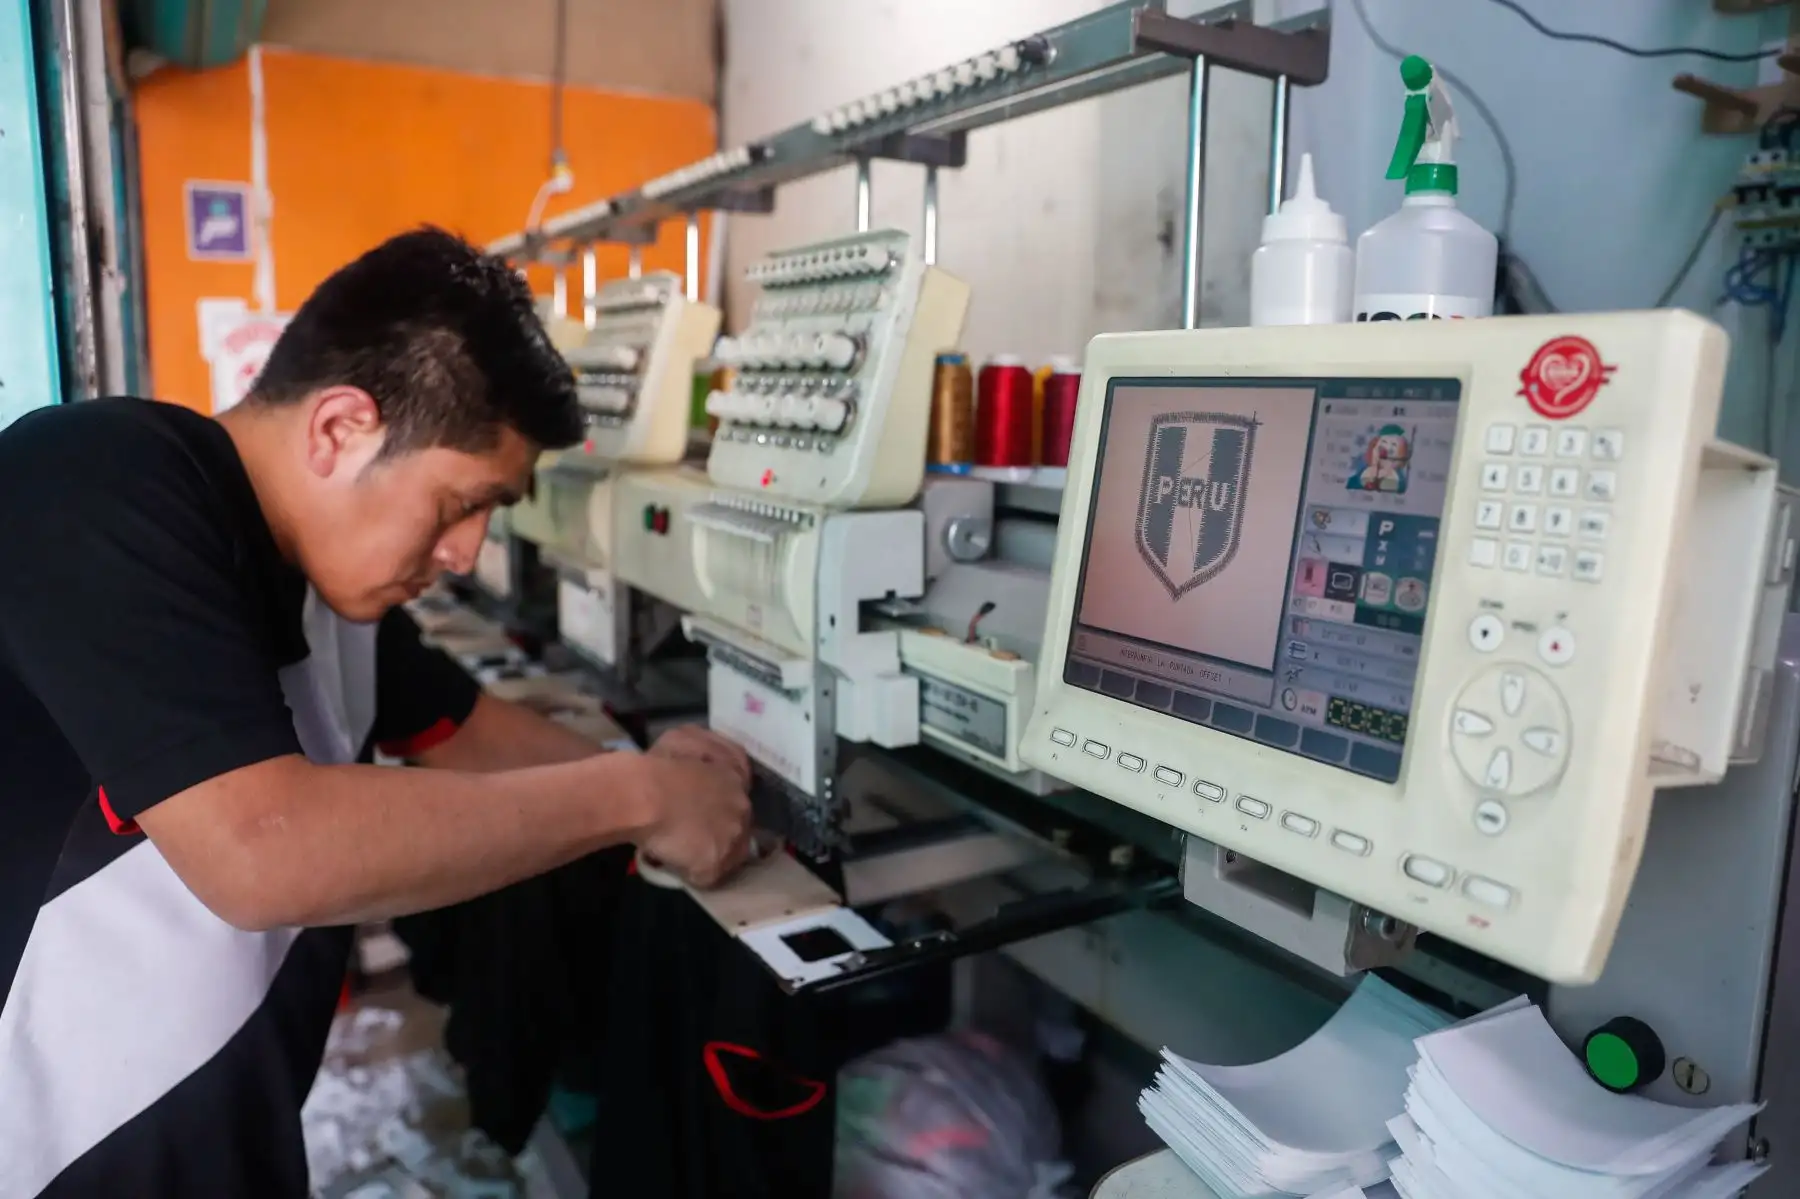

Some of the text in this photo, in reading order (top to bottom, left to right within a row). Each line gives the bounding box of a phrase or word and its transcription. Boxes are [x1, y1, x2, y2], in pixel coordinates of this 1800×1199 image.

[1529, 432, 1538, 450] 2
[1564, 436, 1574, 452] 3
[1488, 467, 1567, 492] 4 5 6
[1154, 475, 1230, 511] PERU
[1480, 505, 1492, 523] 7
[1515, 508, 1527, 526] 8
[1551, 512, 1562, 528] 9
[1378, 520, 1394, 536] P
[1508, 547, 1520, 564] 0
